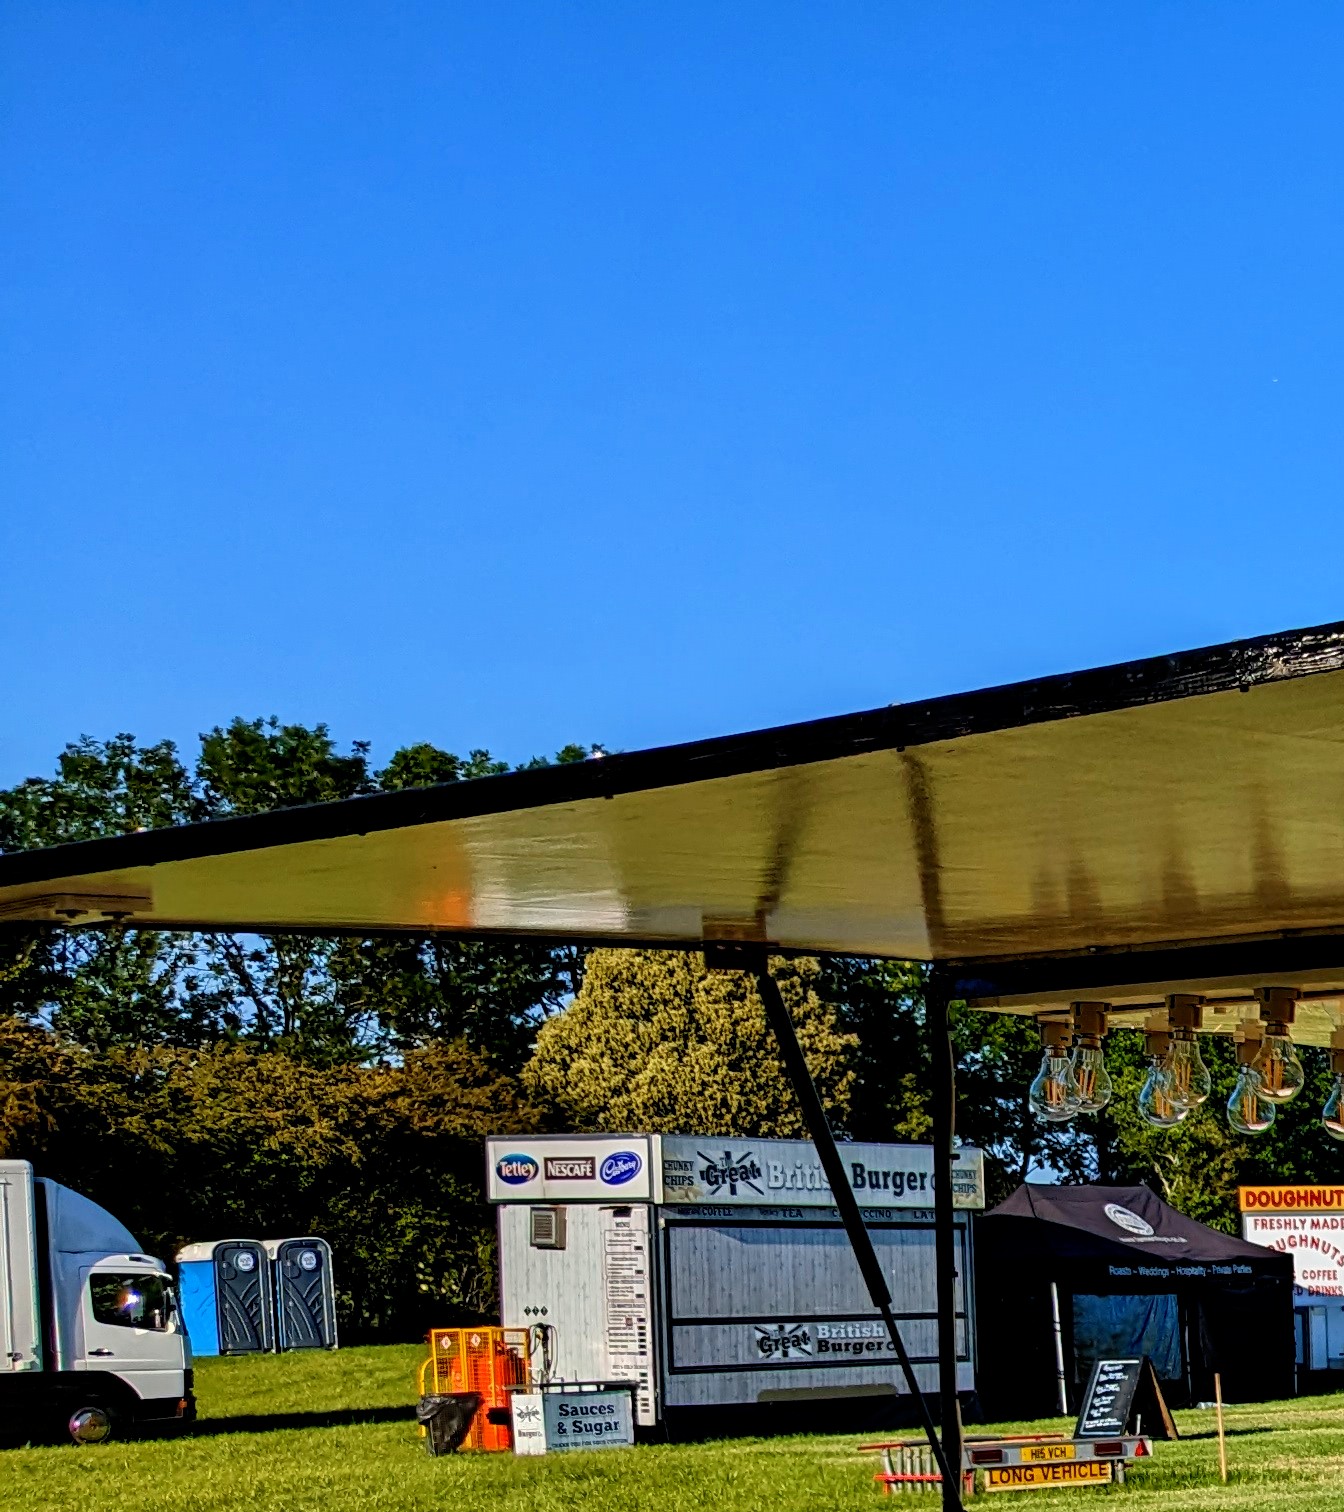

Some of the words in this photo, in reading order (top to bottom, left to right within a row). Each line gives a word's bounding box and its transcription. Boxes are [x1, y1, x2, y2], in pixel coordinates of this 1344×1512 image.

[499, 1161, 536, 1181] Tetley
[547, 1160, 593, 1177] NESCAFÉ
[664, 1160, 694, 1171] CHUNKY
[664, 1175, 694, 1186] CHIPS
[705, 1160, 757, 1186] Great
[767, 1160, 832, 1191] Briti
[851, 1162, 928, 1197] Burger
[782, 1208, 804, 1218] TEA
[913, 1210, 936, 1219] LAT
[1253, 1218, 1306, 1230] FRESHLY
[1302, 1269, 1338, 1280] COFFEE
[1308, 1285, 1343, 1297] DRINKS
[816, 1324, 885, 1339] British
[758, 1331, 810, 1354] Great
[817, 1339, 884, 1354] Burger
[558, 1403, 615, 1417] Sauces
[557, 1422, 567, 1434] &
[572, 1420, 620, 1435] Sugar
[990, 1467, 1034, 1484] LONG
[1042, 1463, 1110, 1481] VEHICLE
